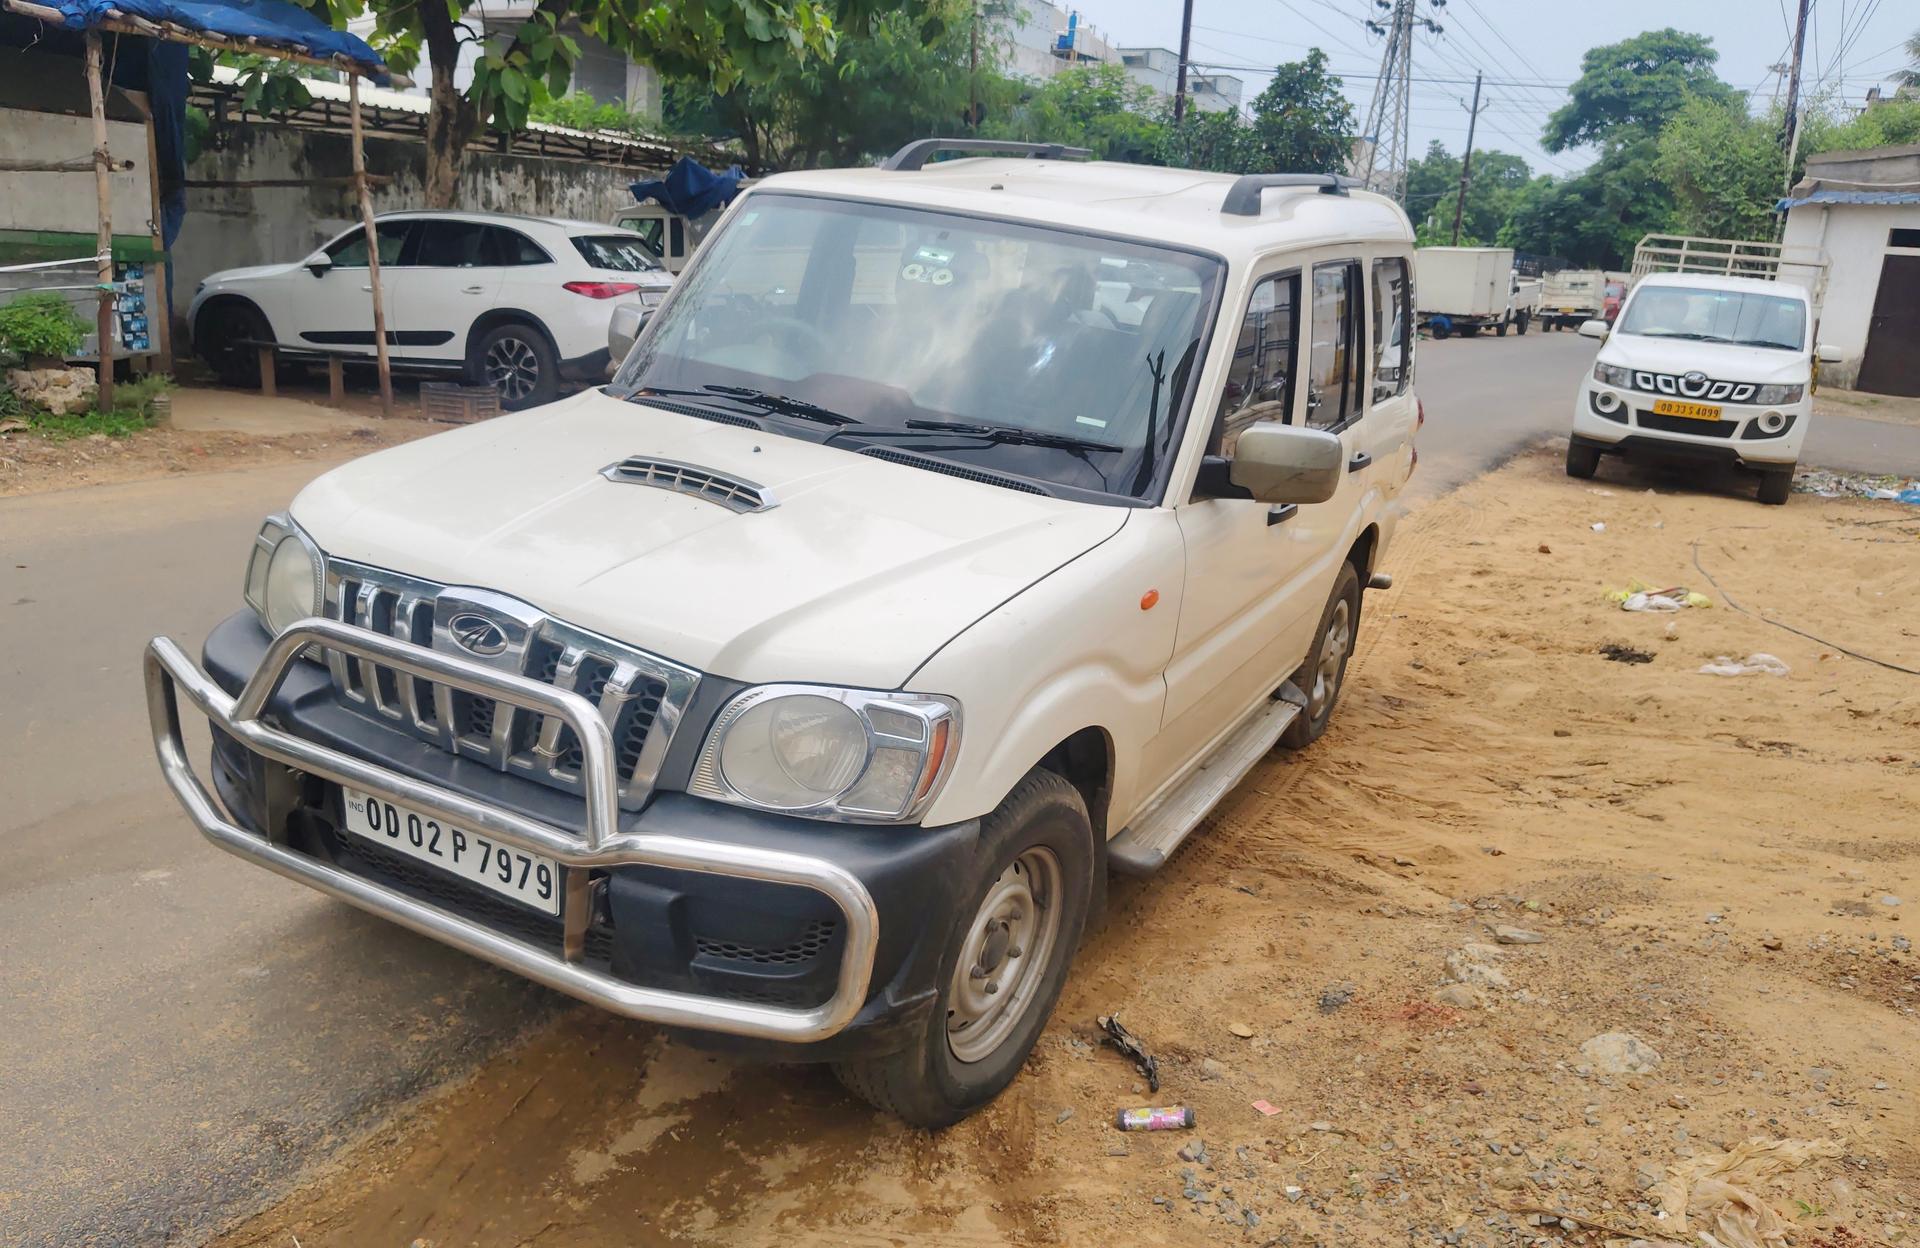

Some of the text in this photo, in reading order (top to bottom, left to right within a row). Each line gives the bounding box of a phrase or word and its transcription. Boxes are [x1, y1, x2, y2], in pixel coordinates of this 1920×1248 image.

[1695, 407, 1719, 418] 4099
[349, 801, 364, 813] IND
[366, 797, 552, 900] OD 02 P 7979
